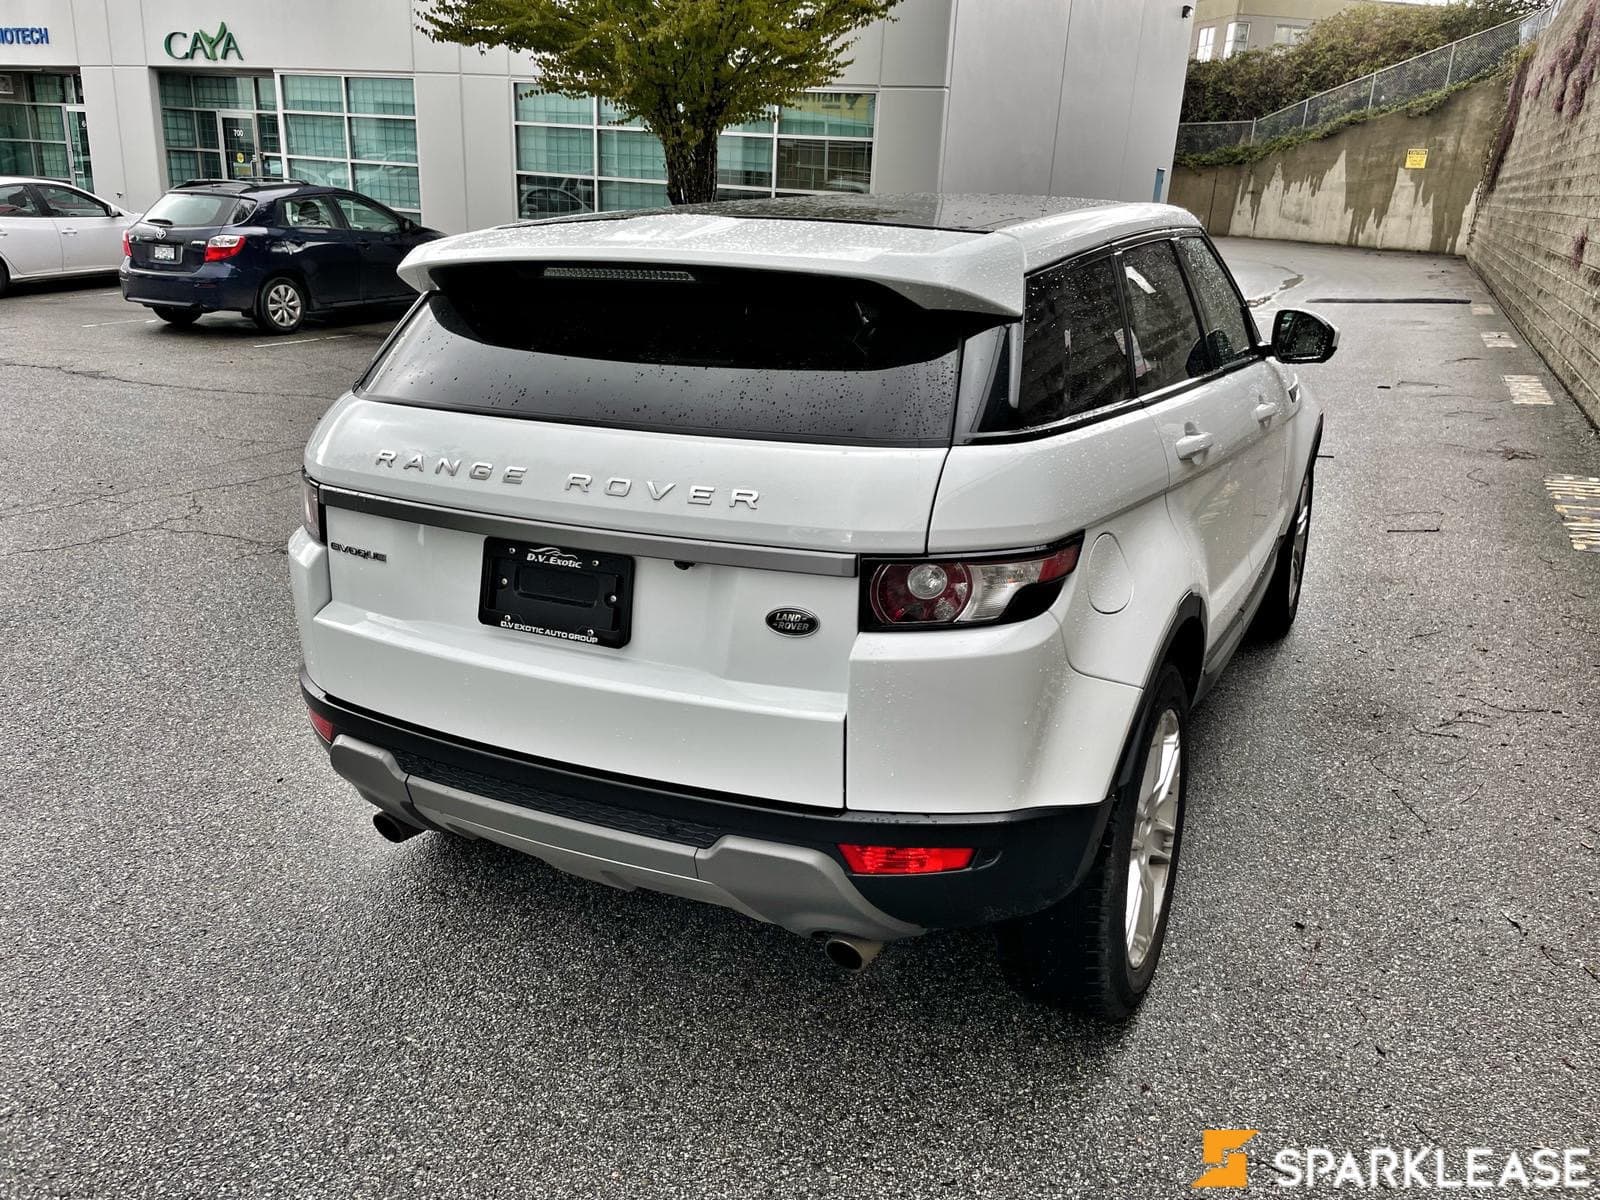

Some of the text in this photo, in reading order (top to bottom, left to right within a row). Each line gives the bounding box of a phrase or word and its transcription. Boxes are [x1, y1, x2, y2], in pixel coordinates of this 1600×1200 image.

[164, 21, 244, 61] CAYA
[233, 129, 244, 137] 700
[375, 449, 760, 510] RANGE ROVER
[514, 623, 545, 635] EXOTIC
[544, 629, 568, 639] AUTO
[568, 632, 599, 644] GROUP
